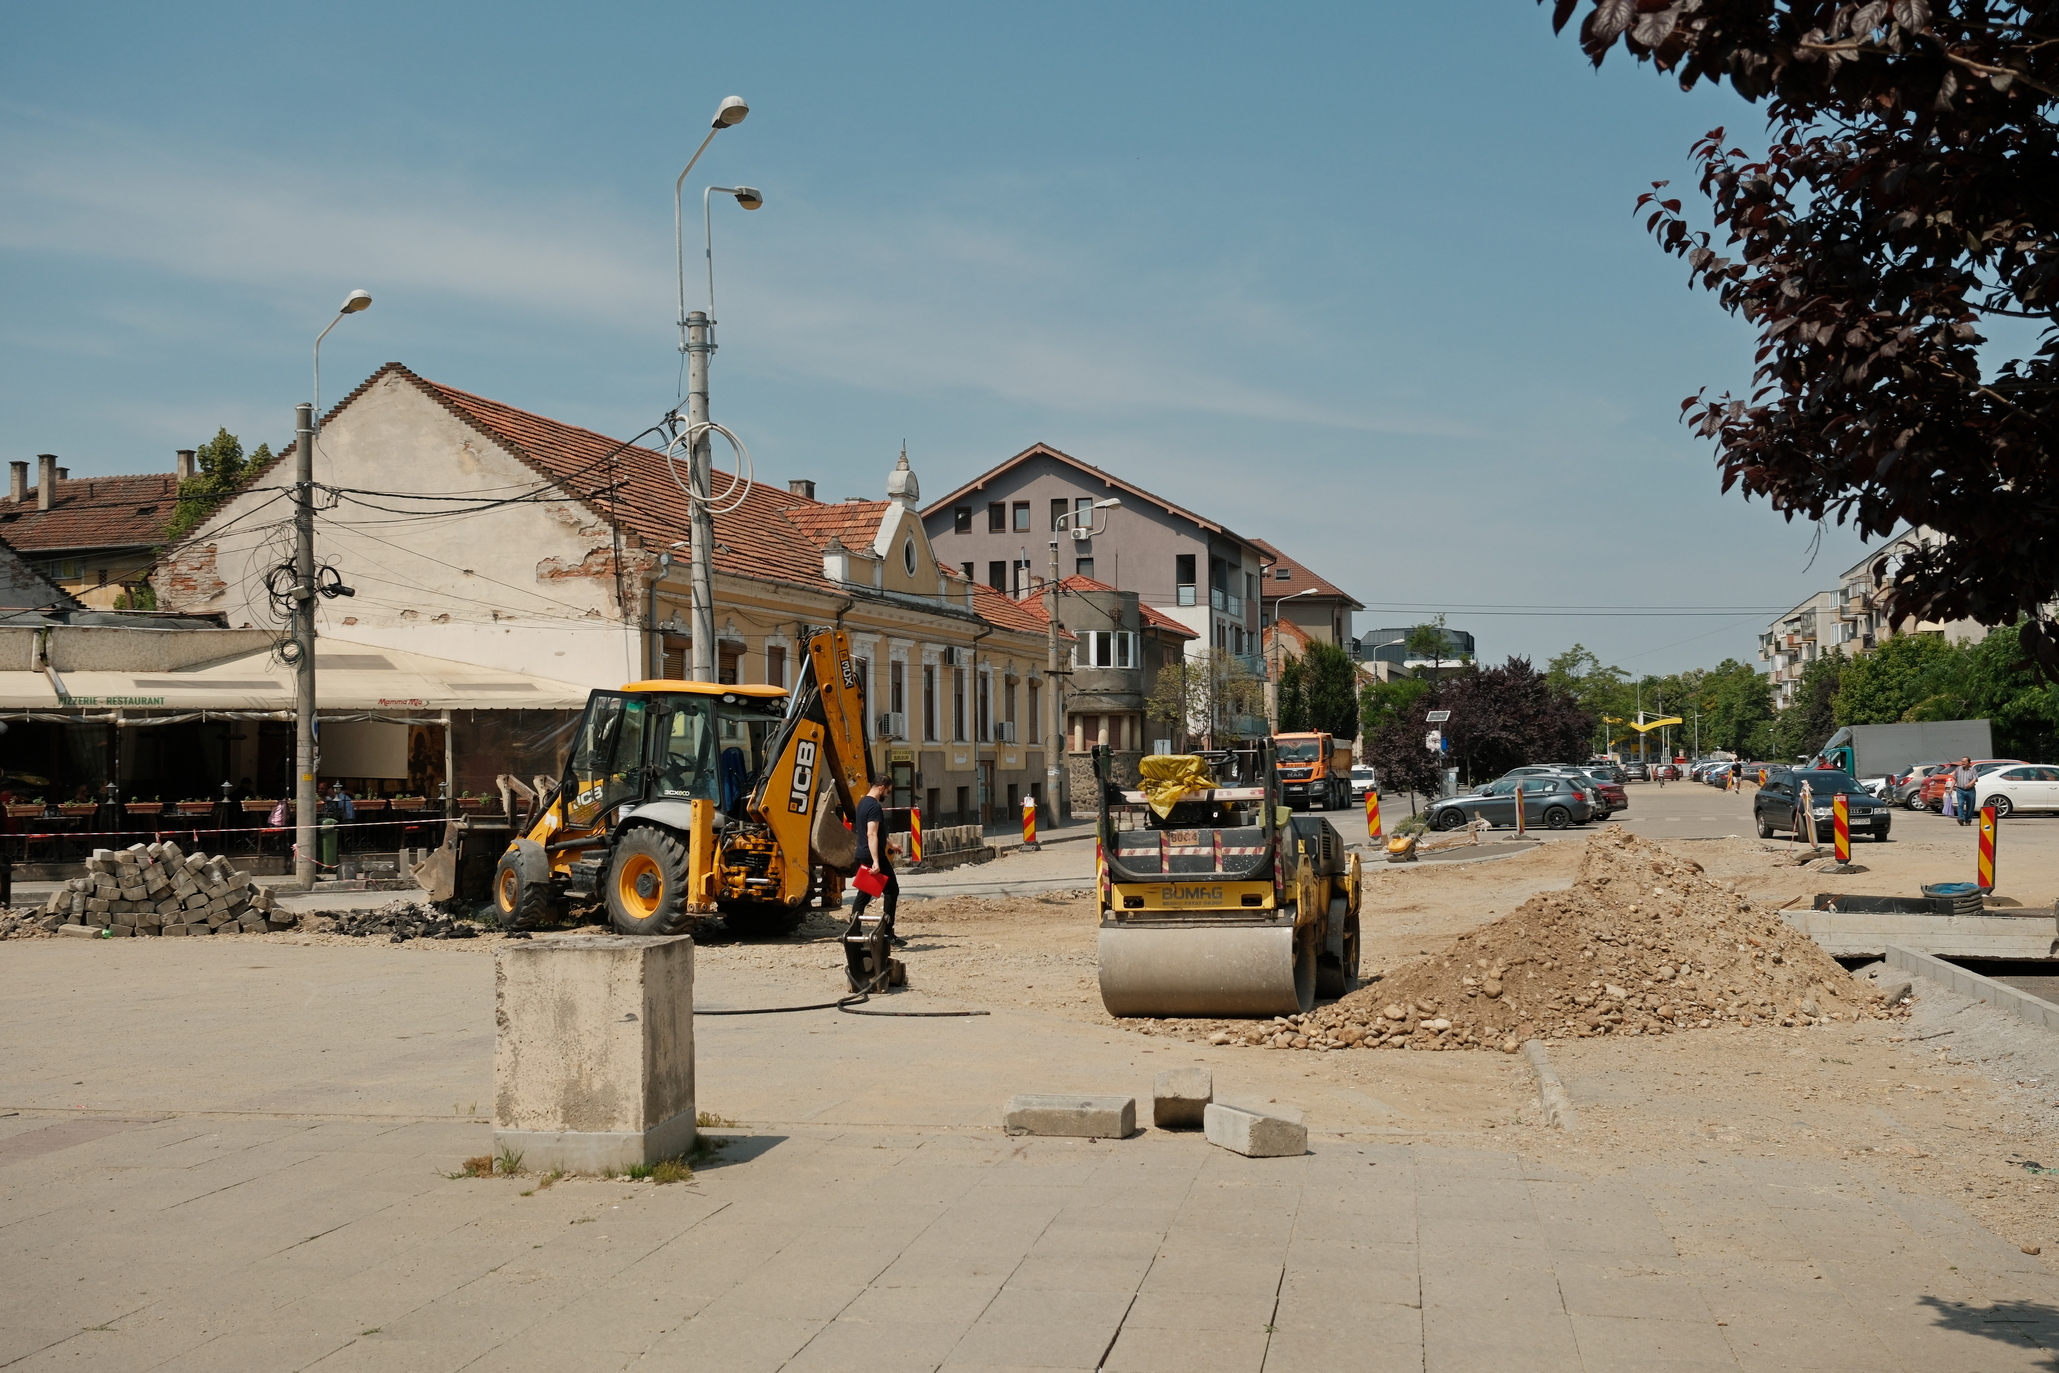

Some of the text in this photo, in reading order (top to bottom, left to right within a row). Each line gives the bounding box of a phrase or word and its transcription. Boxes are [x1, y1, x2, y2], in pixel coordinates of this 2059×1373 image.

[841, 660, 853, 686] 3CX
[58, 697, 98, 705] PIZZERIE
[106, 697, 165, 705] RESTAURANT
[378, 698, 408, 707] Mamma
[791, 741, 815, 813] JCB
[1162, 886, 1222, 900] BOMAG
